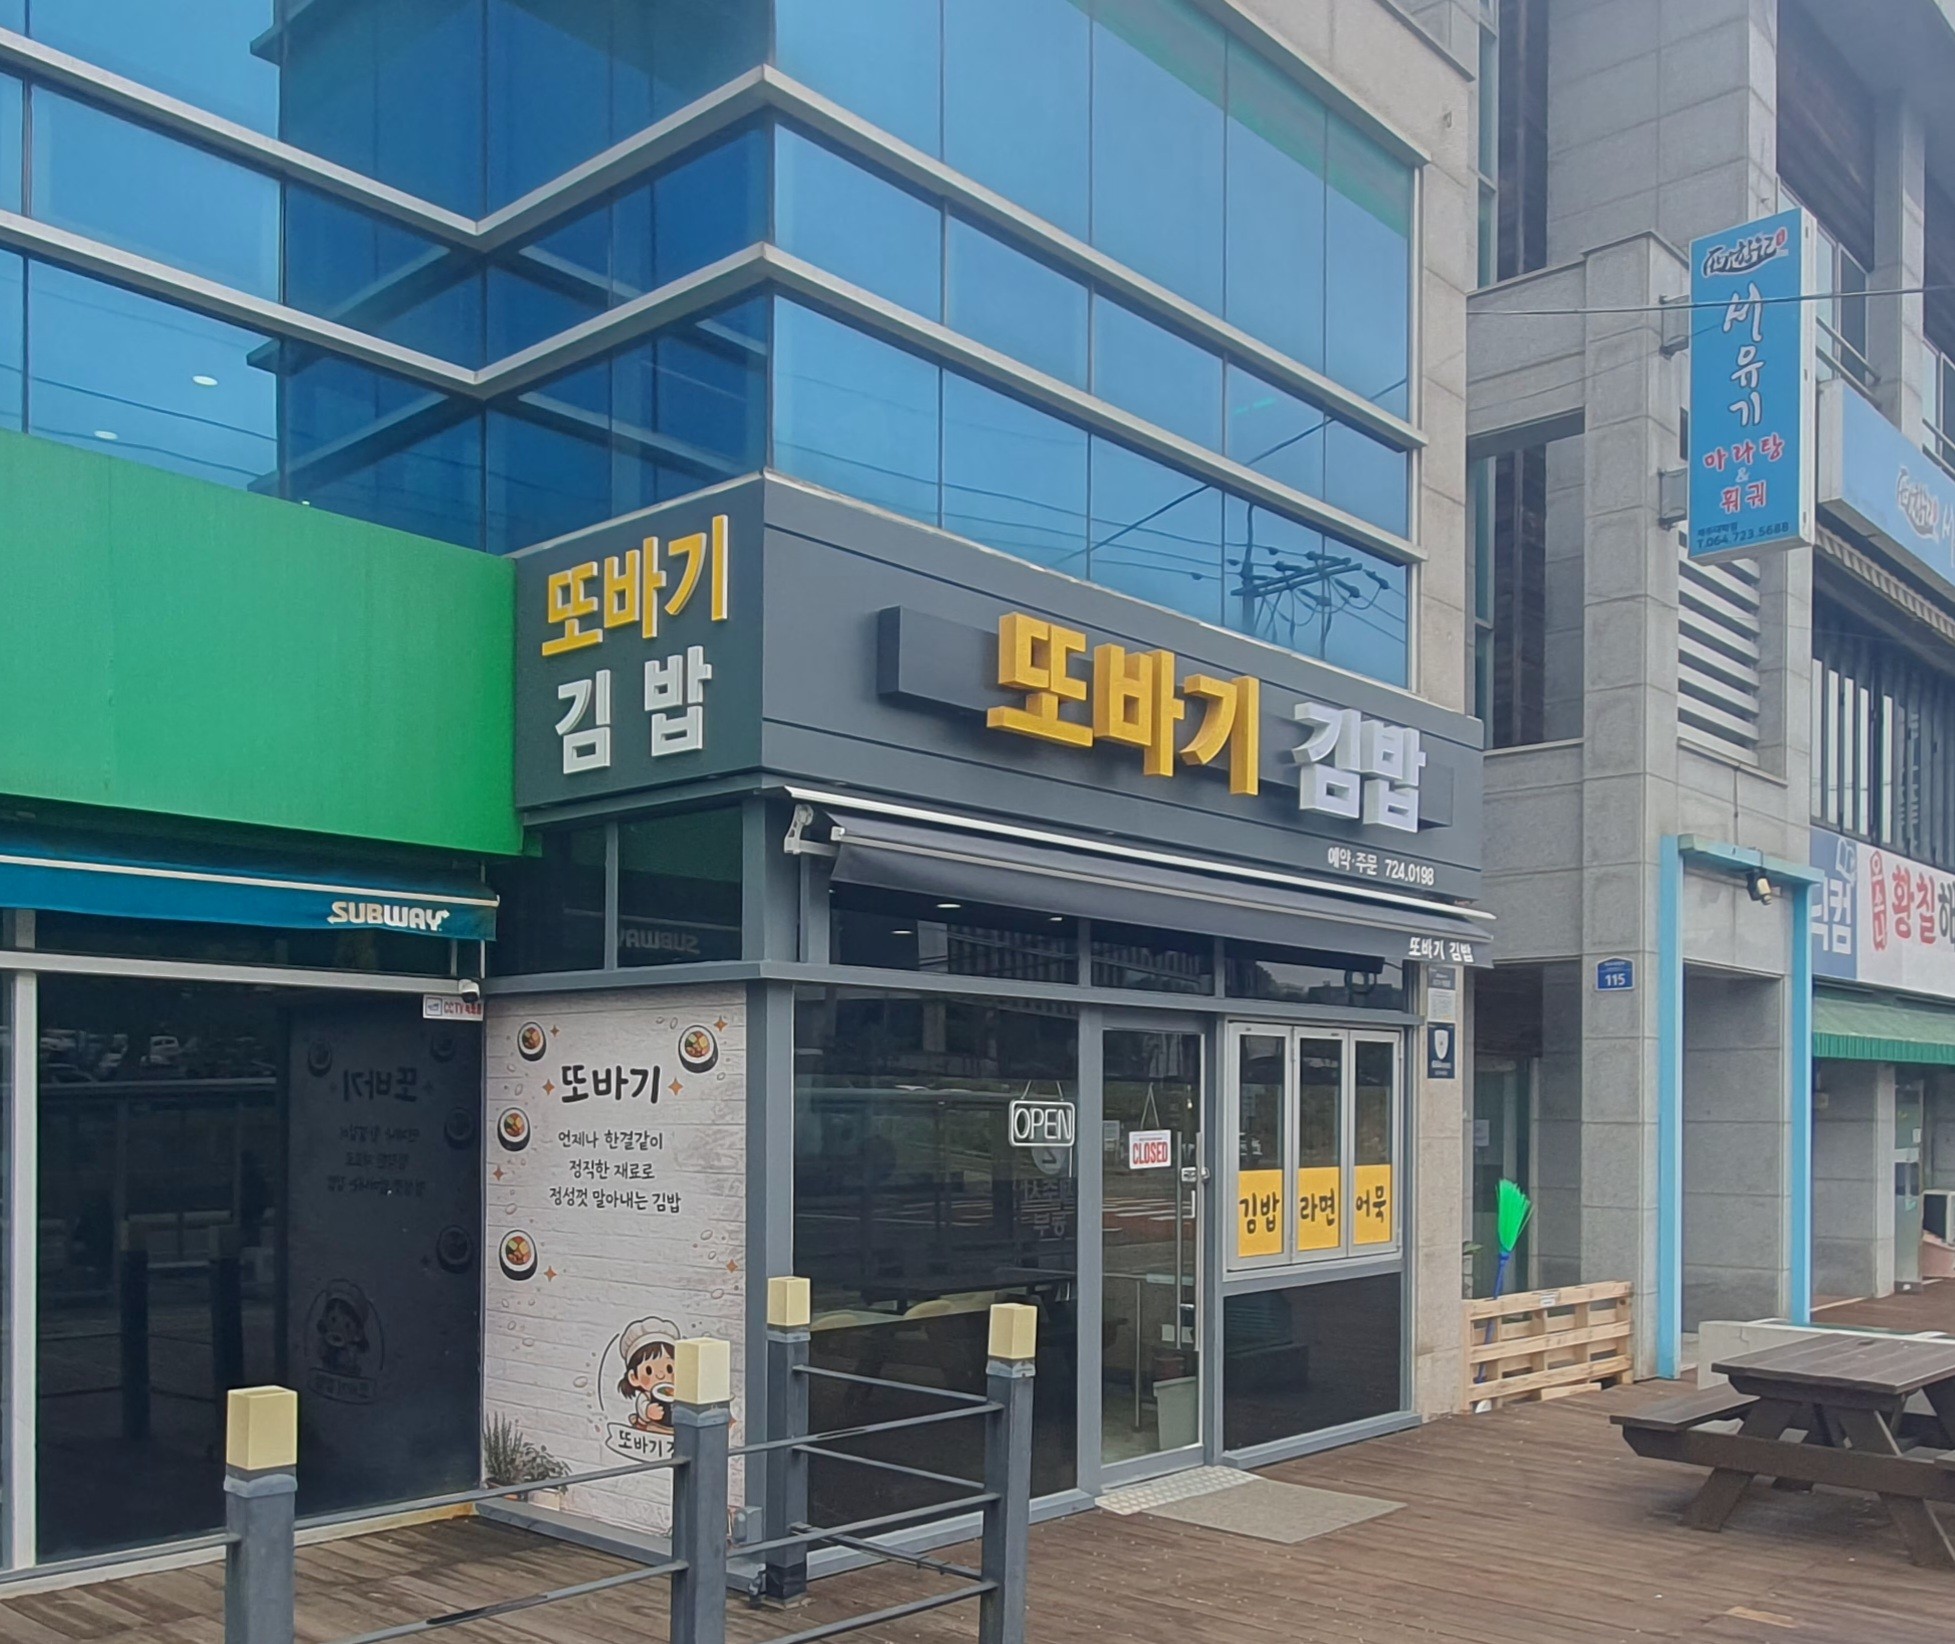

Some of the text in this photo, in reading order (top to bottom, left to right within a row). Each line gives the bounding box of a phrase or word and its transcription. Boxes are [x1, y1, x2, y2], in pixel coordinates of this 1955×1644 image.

[542, 514, 730, 657] 또바기
[986, 611, 1427, 833] 또바기 김밥
[1384, 859, 1435, 886] 724.0198
[326, 901, 451, 931] SUBWAY
[1408, 937, 1474, 963] 또바기 김밥
[1604, 973, 1626, 987] 115
[560, 1064, 661, 1104] 또바기
[1014, 1107, 1072, 1140] OPEN
[558, 1129, 664, 1151] 언제나 한결같이
[1132, 1141, 1168, 1165] CLOSED
[569, 1159, 656, 1180] 정직한 재료로
[549, 1186, 682, 1214] 정성껏 말아내는 김밥
[1239, 1191, 1281, 1234] 김밥
[1300, 1187, 1336, 1227] 라면
[1355, 1185, 1387, 1223] 어묵
[618, 1429, 663, 1458] 또바기
